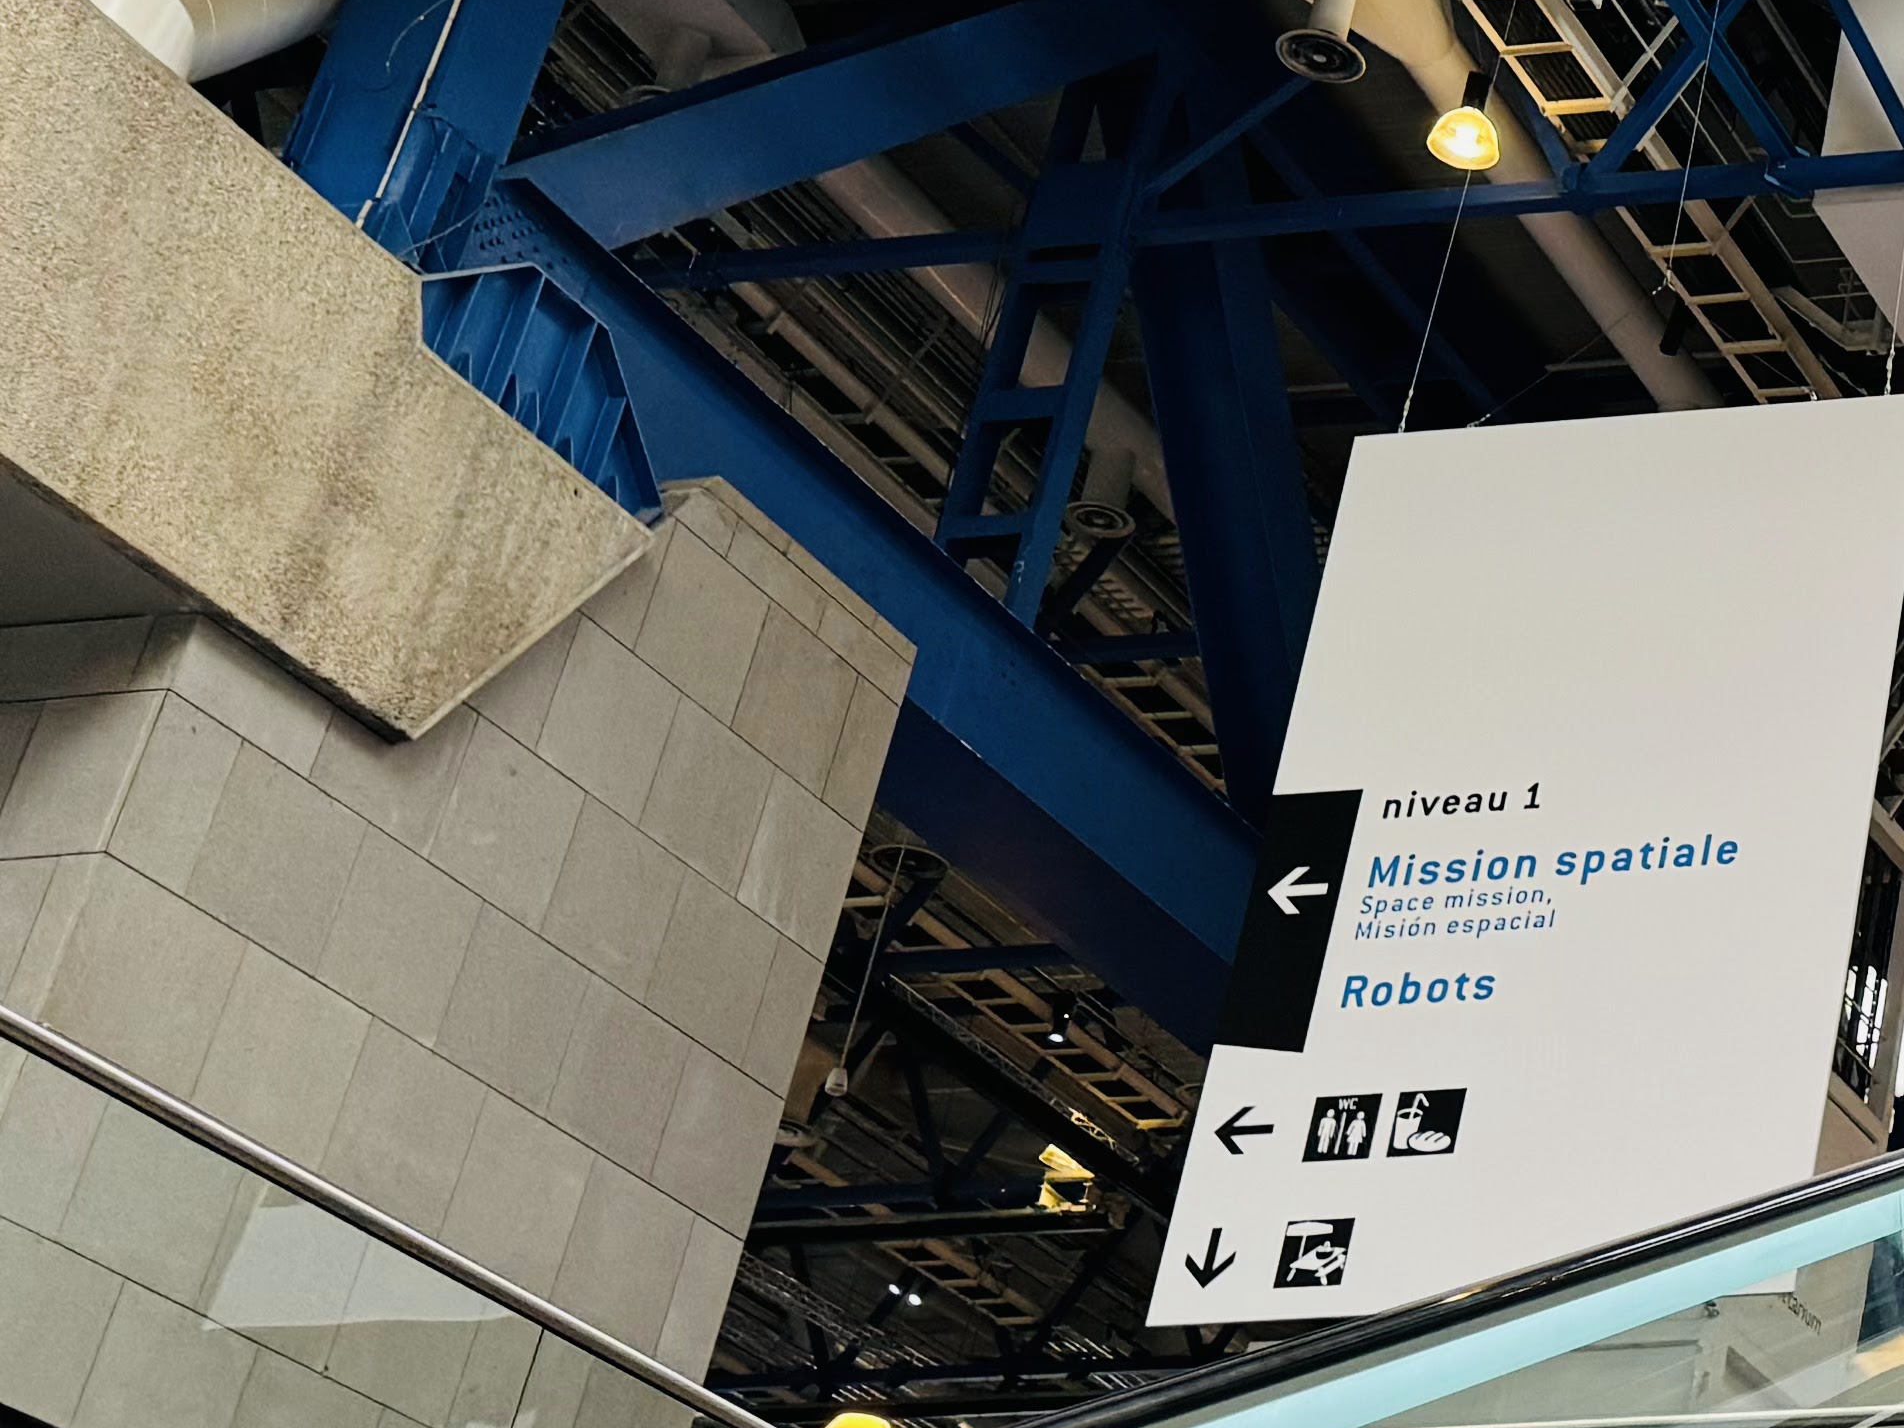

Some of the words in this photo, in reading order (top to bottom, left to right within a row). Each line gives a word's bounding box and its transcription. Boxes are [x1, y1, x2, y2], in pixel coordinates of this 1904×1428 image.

[1382, 790, 1508, 820] niveau
[1523, 782, 1541, 810] 1
[1367, 848, 1537, 889] Mission
[1554, 833, 1739, 886] spatiale
[1359, 895, 1434, 920] Space
[1444, 888, 1552, 909] mission,
[1354, 916, 1436, 941] Misión
[1446, 909, 1556, 939] espacial
[1340, 971, 1496, 1009] Robots
[1338, 1098, 1358, 1110] WC
